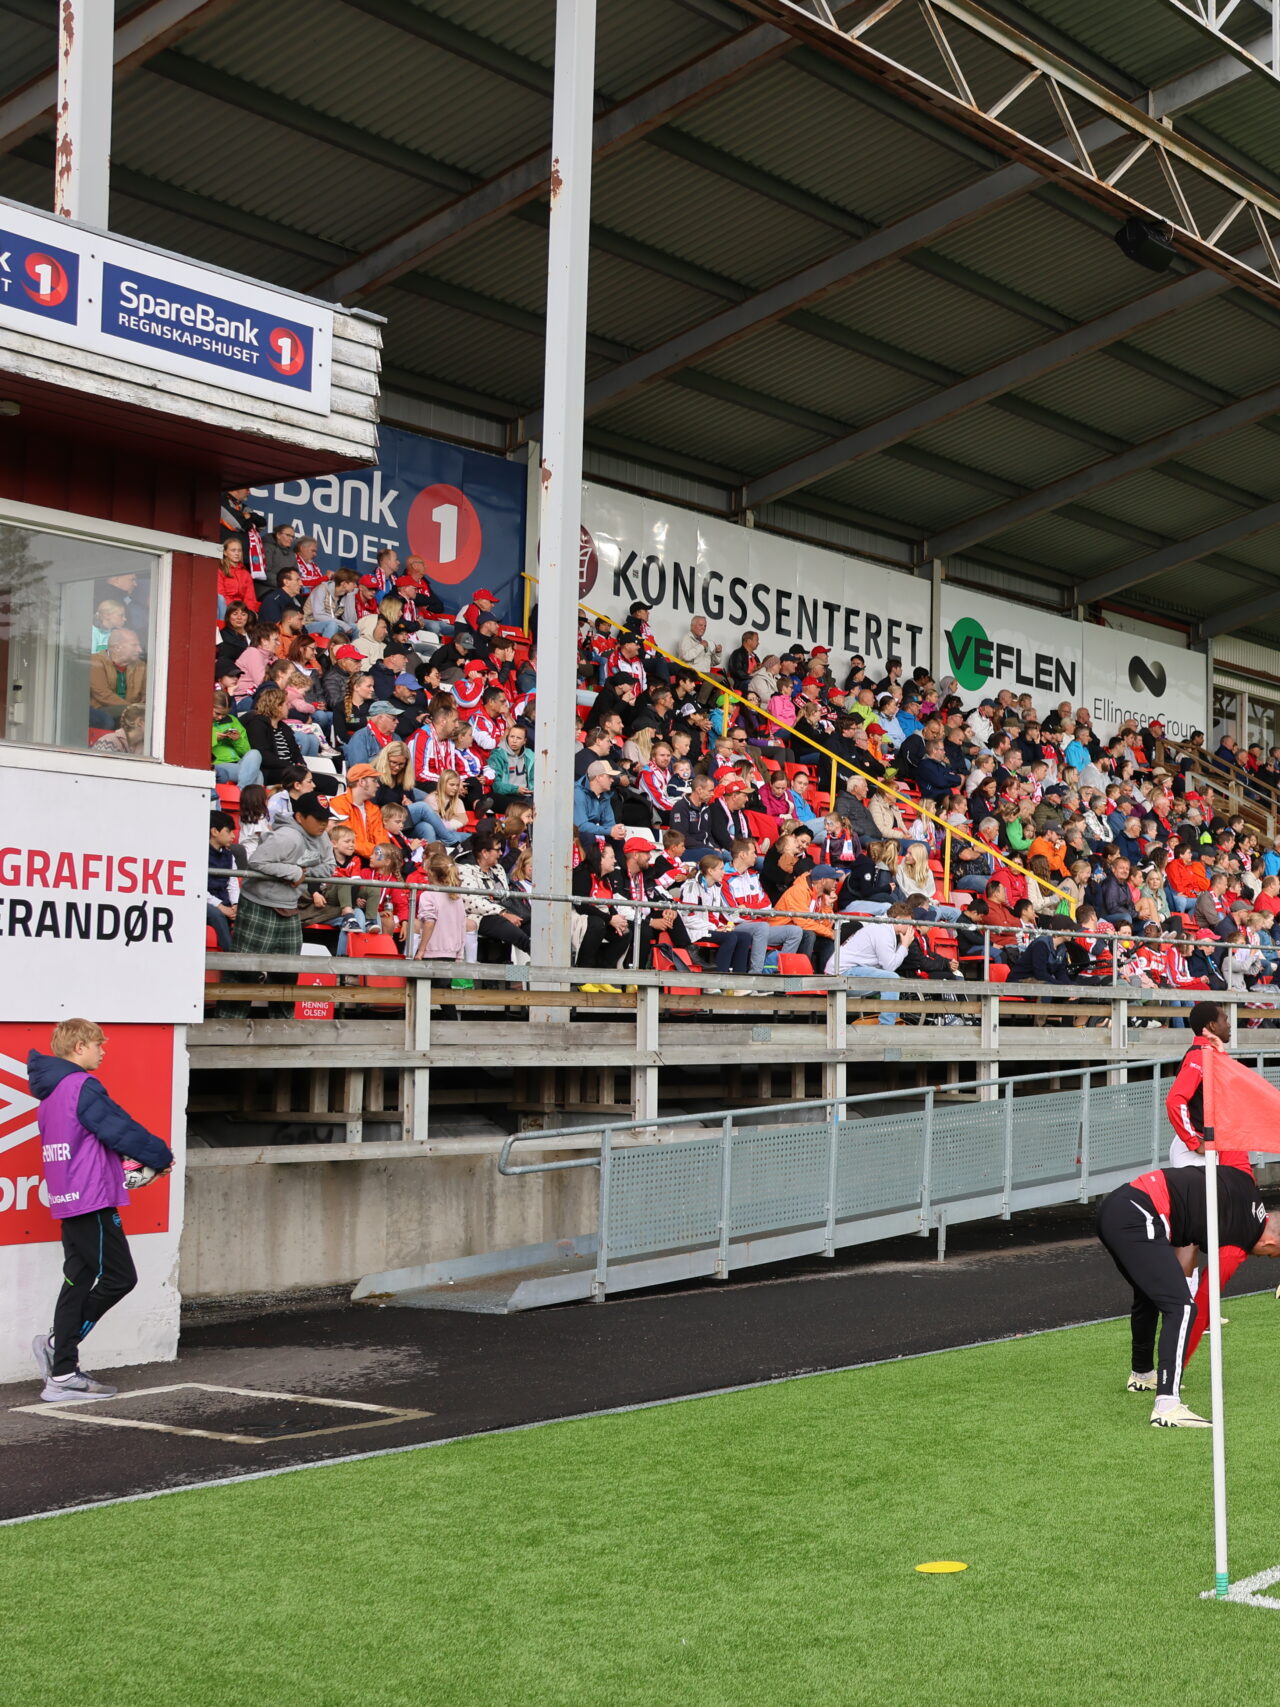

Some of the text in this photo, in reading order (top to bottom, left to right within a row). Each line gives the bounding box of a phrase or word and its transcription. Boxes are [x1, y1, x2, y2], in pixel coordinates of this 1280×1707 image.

[118, 312, 260, 365] REGNSKAPSHUSET
[119, 281, 260, 346] SpareBank
[250, 471, 458, 564] Bank 1
[612, 547, 923, 667] KONGSSENTERET
[943, 629, 1076, 697] VEFLEN
[0, 847, 187, 897] GRAFISKE
[0, 898, 174, 947] RANDØR
[301, 1001, 329, 1009] HENNIG
[303, 1009, 327, 1017] OLSEN
